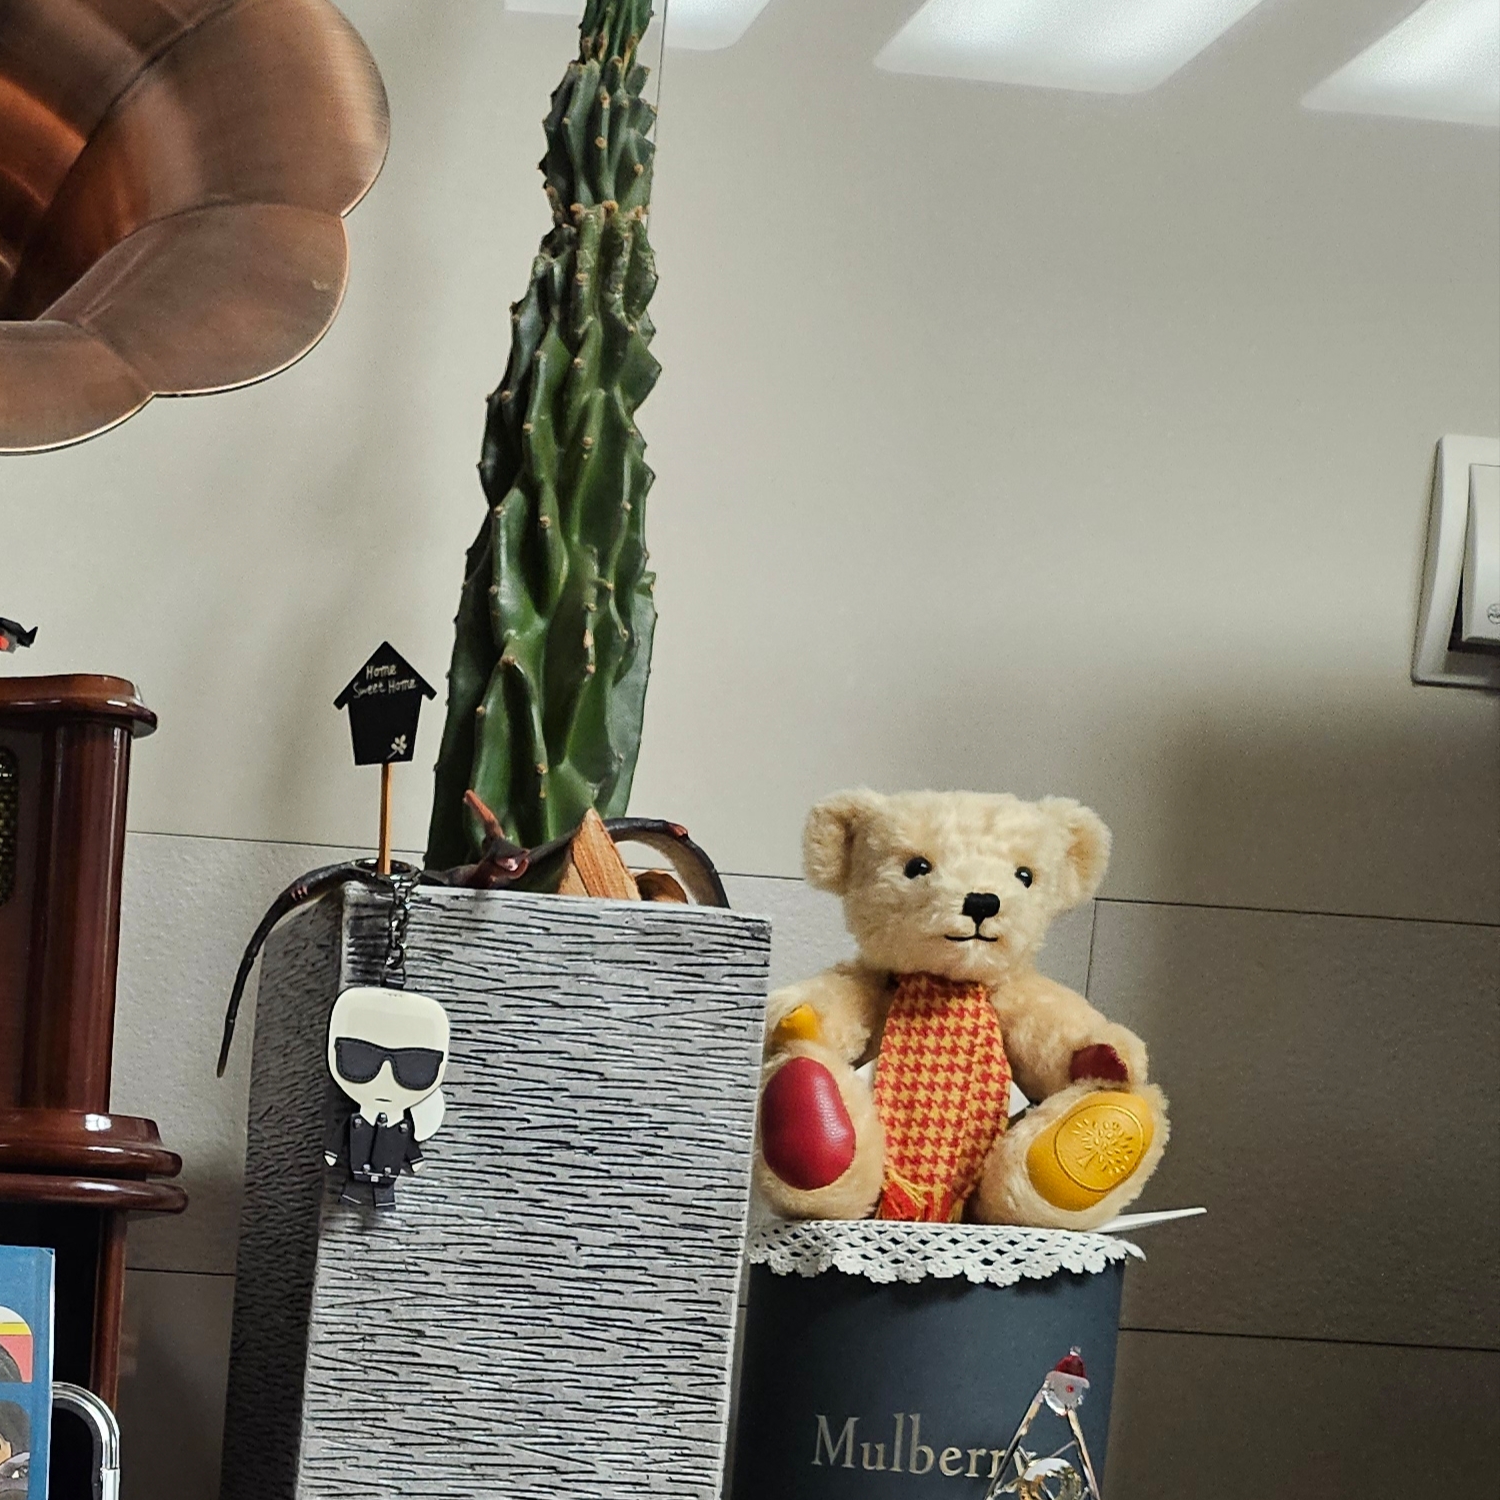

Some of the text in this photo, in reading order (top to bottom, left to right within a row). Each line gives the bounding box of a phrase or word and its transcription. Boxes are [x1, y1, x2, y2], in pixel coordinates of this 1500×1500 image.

[366, 664, 397, 679] Home
[353, 679, 417, 699] Sweet Home
